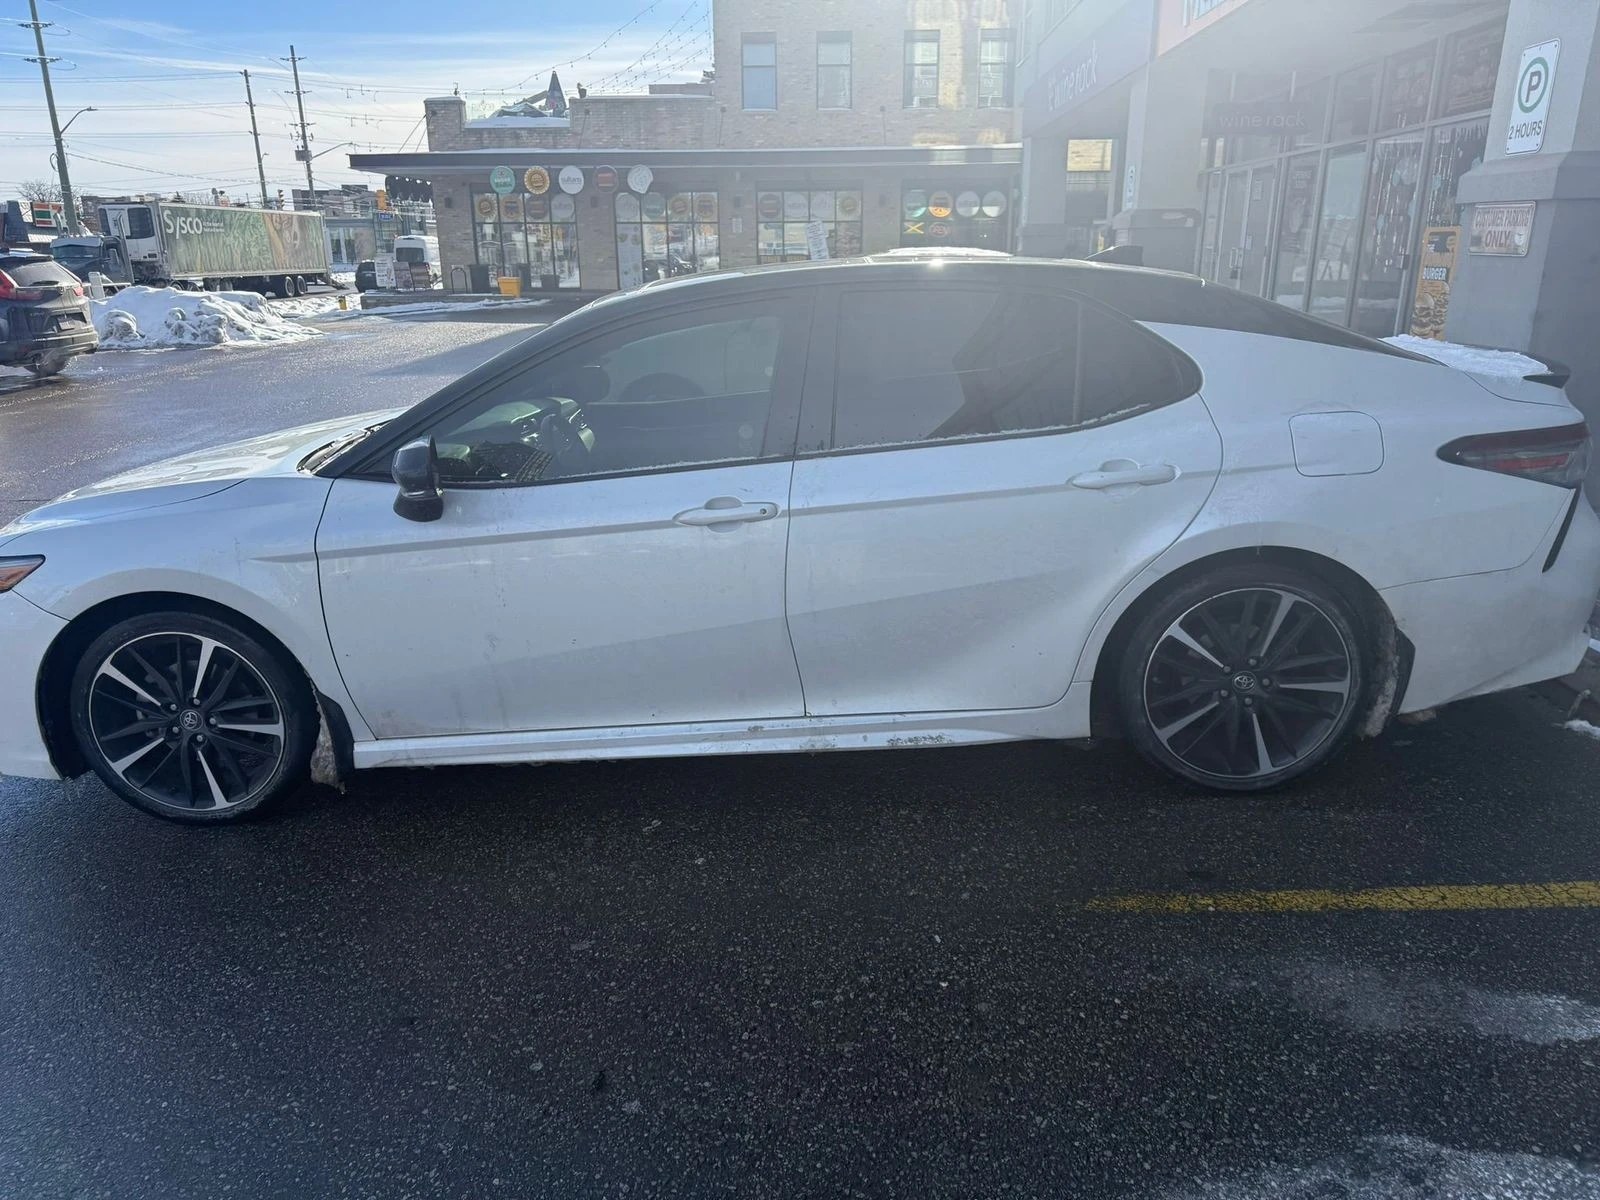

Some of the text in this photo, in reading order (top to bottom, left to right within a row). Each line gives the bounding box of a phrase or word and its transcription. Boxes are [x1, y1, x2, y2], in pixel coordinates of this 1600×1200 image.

[1525, 70, 1542, 103] P
[1219, 110, 1305, 128] wine rack
[1508, 120, 1542, 140] 2 HOURS
[1485, 230, 1511, 248] ONLY
[1422, 267, 1447, 280] BURGER
